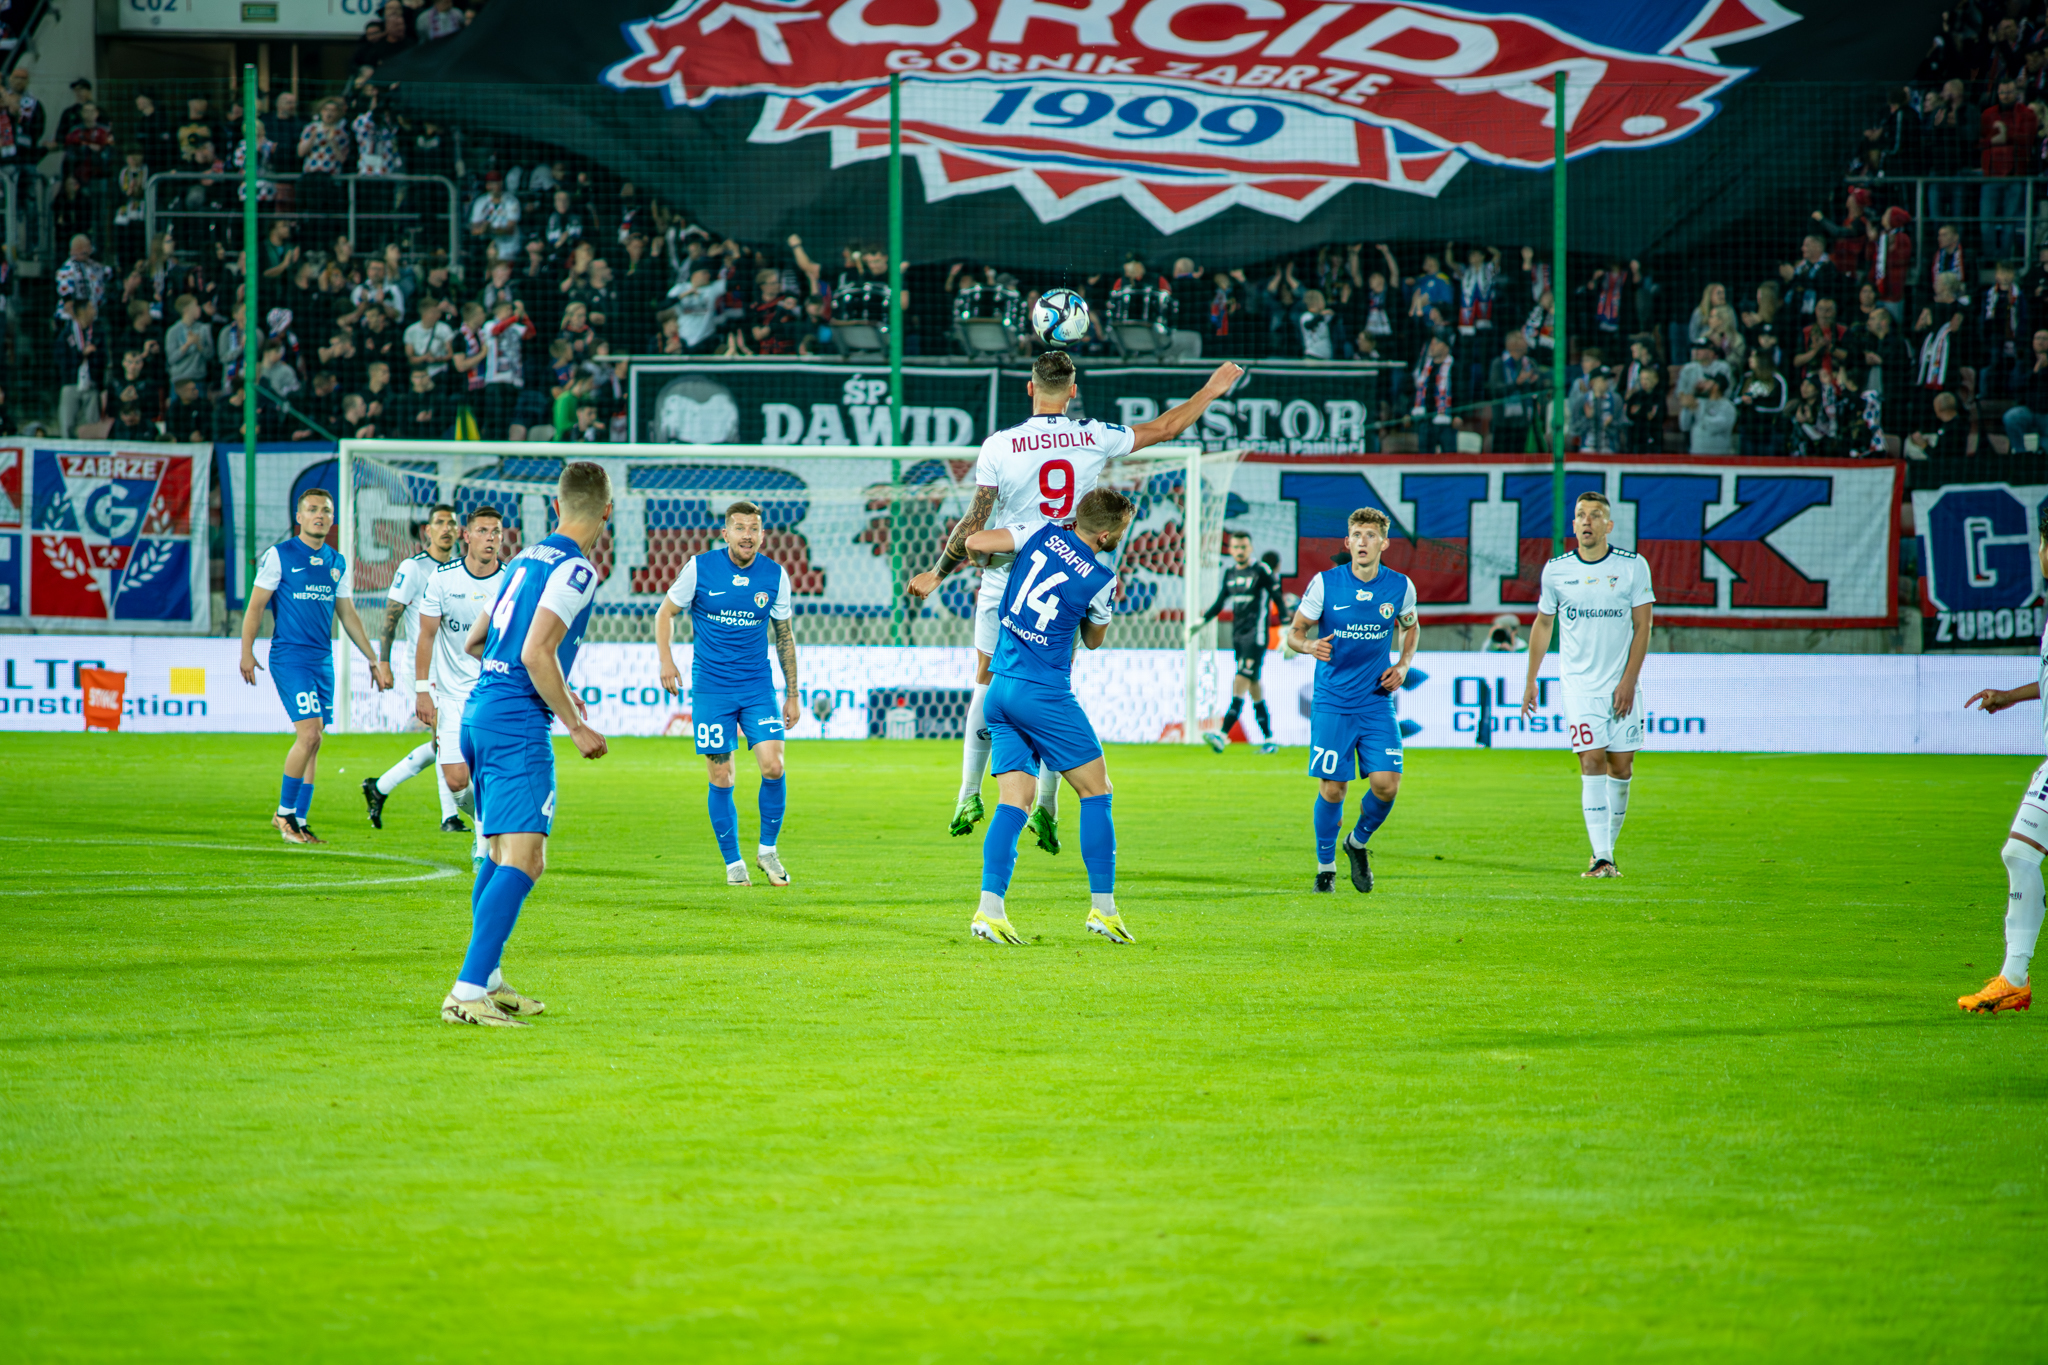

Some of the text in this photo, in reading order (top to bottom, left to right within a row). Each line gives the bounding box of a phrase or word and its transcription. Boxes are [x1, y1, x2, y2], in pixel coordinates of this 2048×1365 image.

[698, 0, 1608, 132] TORCIDA
[885, 41, 1393, 104] GÓRNIK ZABRZE
[981, 86, 1285, 146] 1999
[761, 402, 974, 446] DAWID
[1012, 431, 1096, 453] MUSIOLIK
[66, 457, 157, 479] ZABRZE
[1039, 459, 1075, 518] 9
[1045, 535, 1094, 578] SERAFIN
[305, 584, 332, 593] MIASTO
[1010, 549, 1069, 632] 14
[720, 609, 755, 619] MIASTO
[1578, 608, 1623, 619] WĘGLOKOKS
[1346, 623, 1381, 632] MIASTO
[296, 691, 321, 715] 96
[697, 723, 724, 748] 93
[1570, 723, 1593, 747] 26
[1311, 746, 1338, 775] 70
